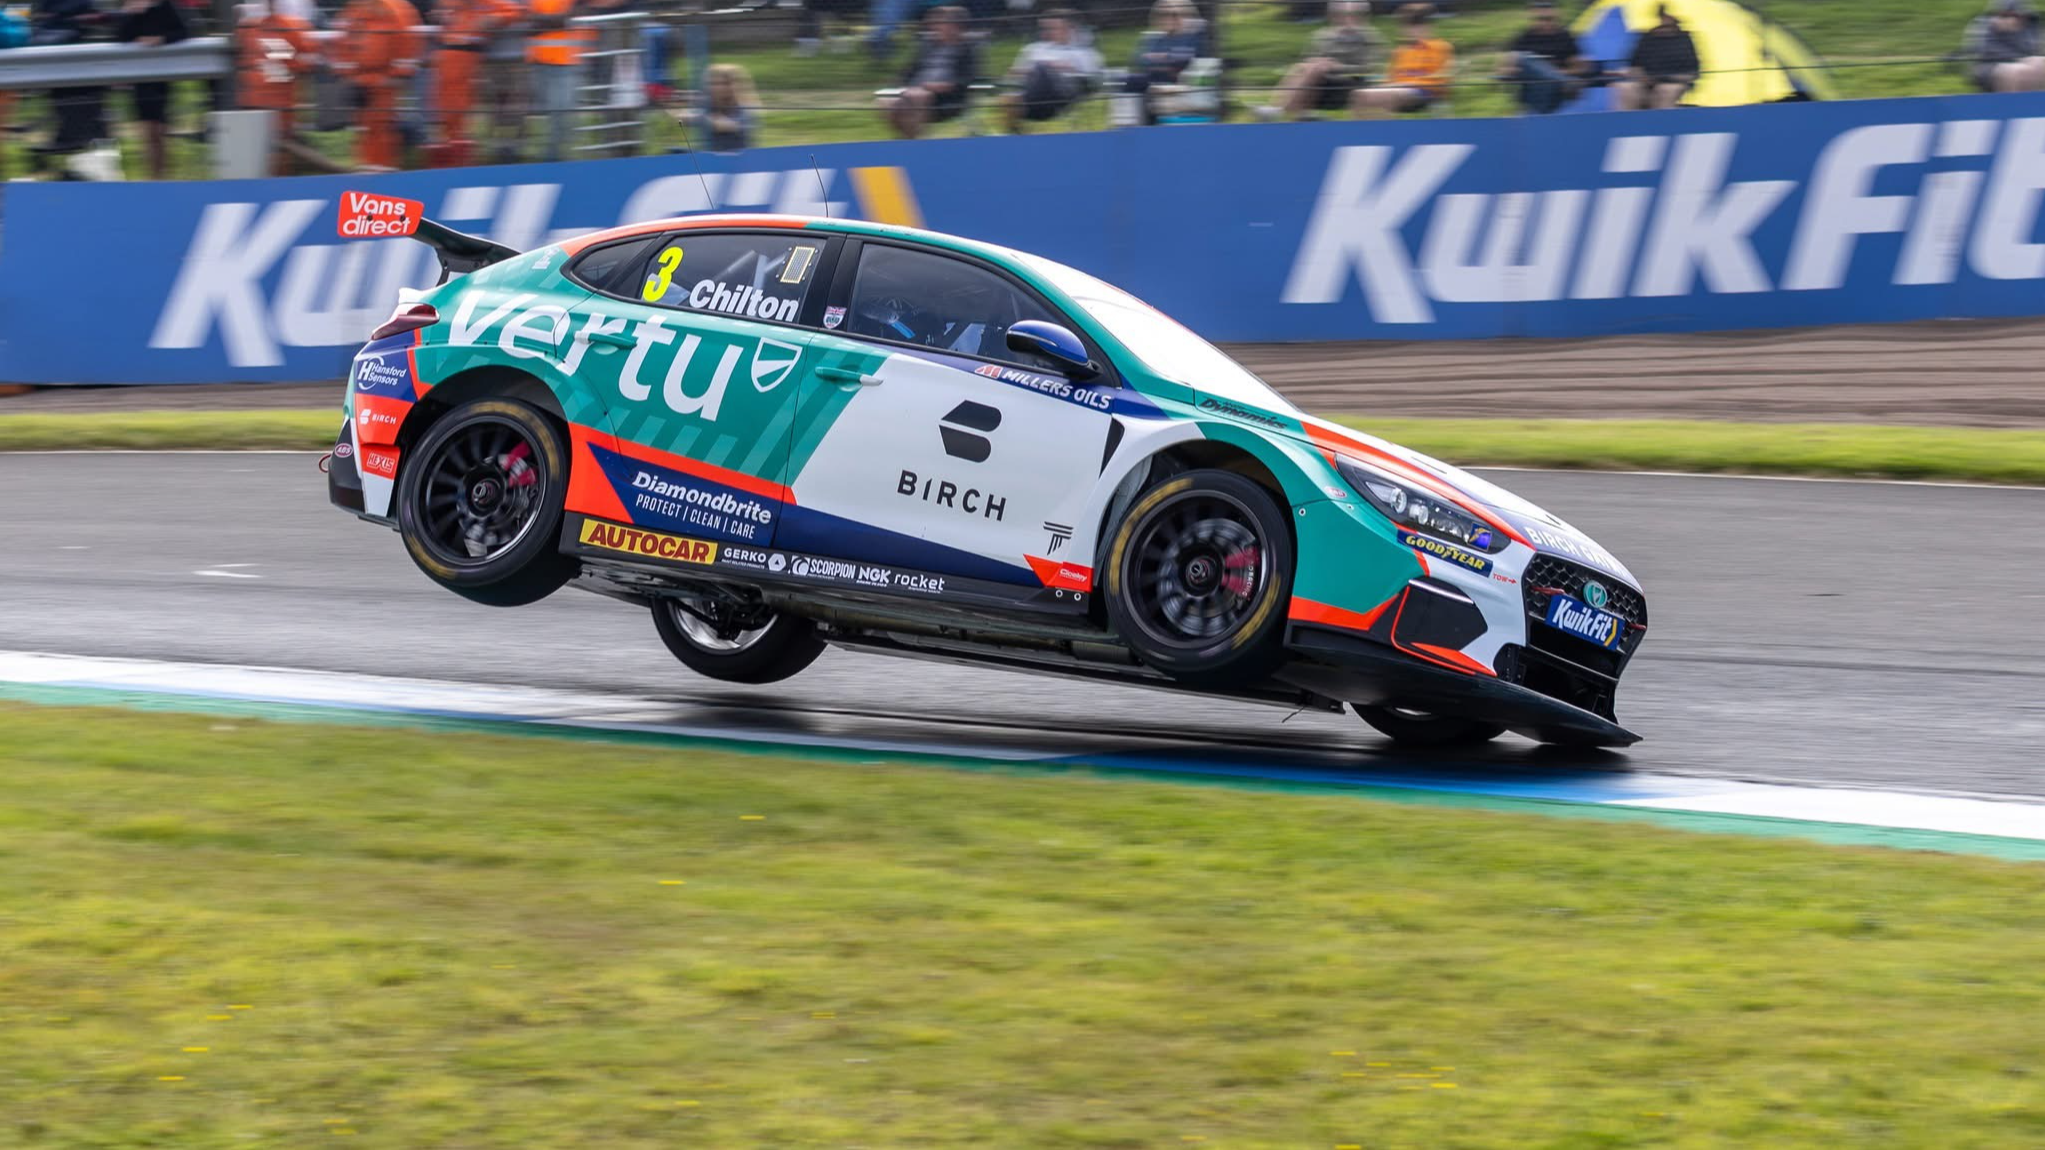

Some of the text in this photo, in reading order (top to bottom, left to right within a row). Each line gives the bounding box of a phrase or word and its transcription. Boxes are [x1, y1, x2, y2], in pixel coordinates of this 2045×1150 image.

[350, 193, 406, 216] Vans
[343, 217, 411, 235] direct
[643, 246, 684, 302] 3
[689, 279, 800, 322] Chilton
[449, 290, 743, 421] vertu
[368, 372, 398, 386] Sensors
[371, 363, 406, 378] Hansford
[1002, 370, 1112, 410] MILLERS OILS
[372, 413, 397, 425] BIRCH
[1200, 398, 1287, 429] Dynamics
[367, 453, 395, 473] HEXIS
[632, 471, 772, 525] Diamondbrite
[897, 470, 1006, 521] BIRCH
[636, 494, 756, 540] PROTECT CLEAN CARE
[588, 523, 710, 562] AUTOCAR
[1406, 535, 1486, 570] GOODYEAR
[724, 547, 766, 563] GERKO
[810, 558, 856, 579] SCORPION
[858, 566, 891, 584] NGK
[1493, 572, 1508, 583] TOW
[894, 574, 945, 591] rocket
